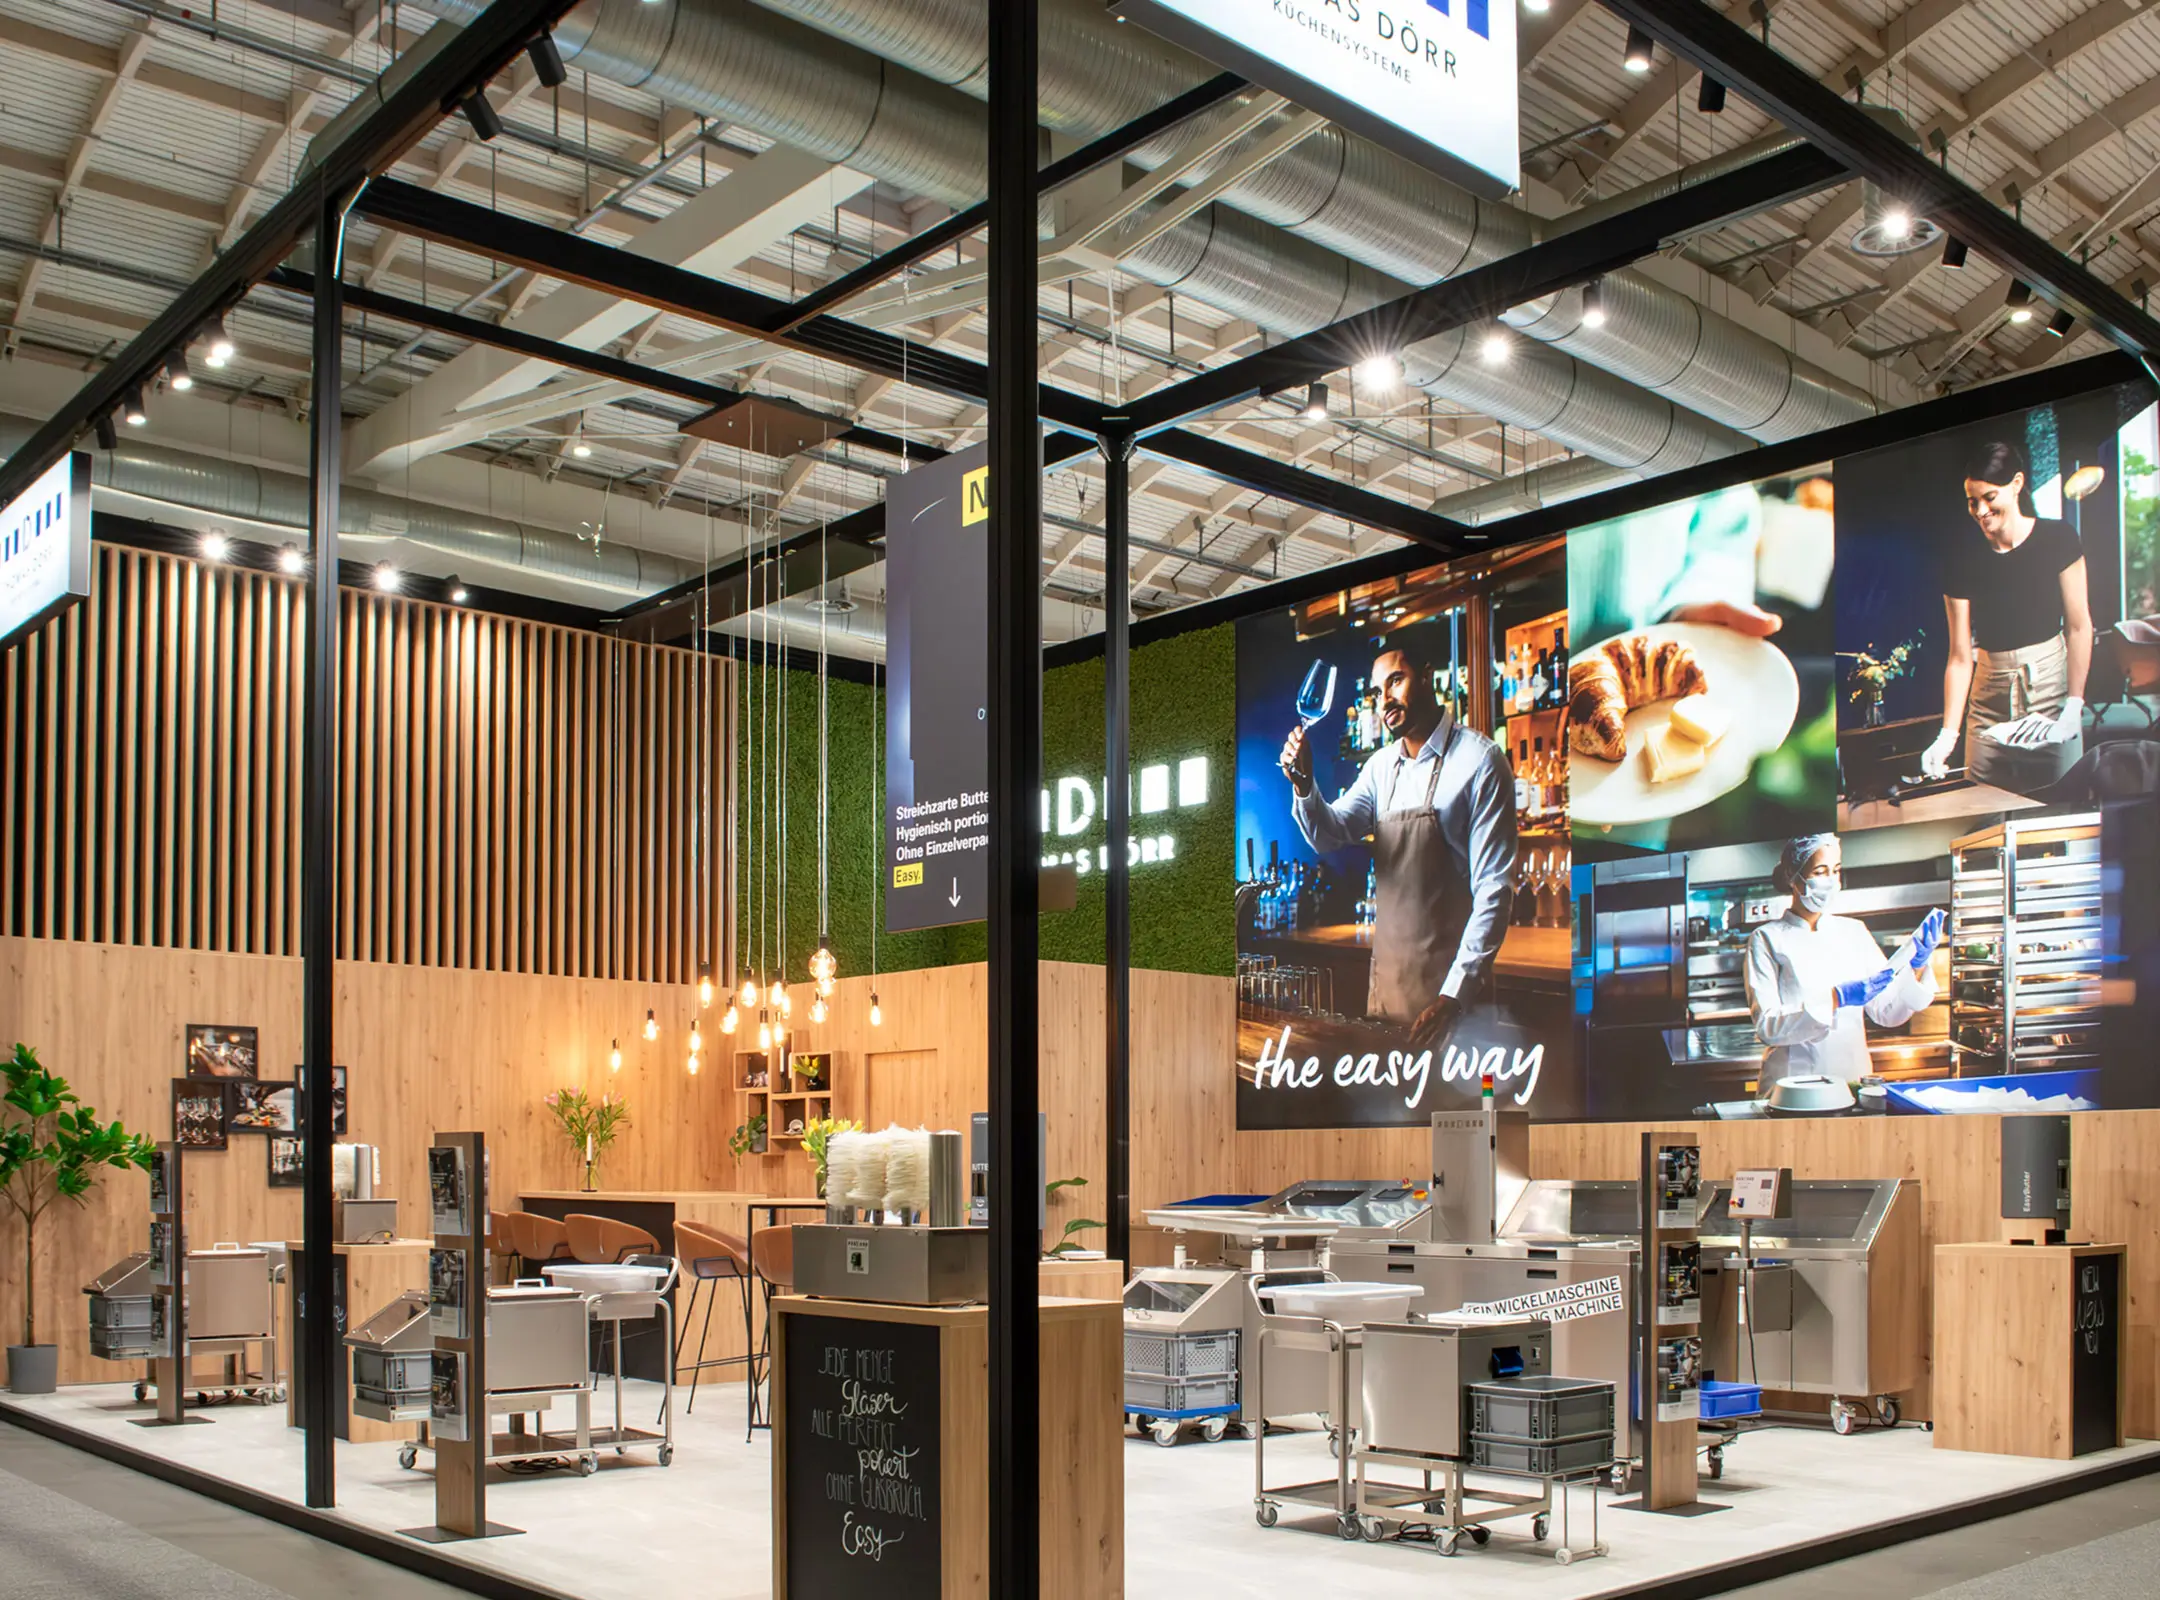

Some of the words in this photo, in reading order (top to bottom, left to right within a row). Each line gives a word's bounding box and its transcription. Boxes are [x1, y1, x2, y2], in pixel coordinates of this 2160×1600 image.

[1272, 0, 1412, 84] KÜCHENSYSTEME
[1378, 11, 1457, 78] DÖRR
[896, 797, 958, 820] Streichzarte
[896, 817, 951, 843] Hygienisch
[896, 846, 924, 861] Ohne
[1255, 1025, 1323, 1089] the
[1333, 1050, 1433, 1109] easy
[1441, 1044, 1545, 1106] way
[2023, 1171, 2032, 1212] EasyButter
[1554, 1295, 1622, 1320] MACHINE
[818, 1346, 850, 1378] JEDE
[856, 1349, 895, 1384] MENGE
[811, 1408, 833, 1438] ALLE
[839, 1413, 896, 1450] PERFEKT
[826, 1472, 856, 1505] OHNE
[842, 1511, 904, 1562] Easy
